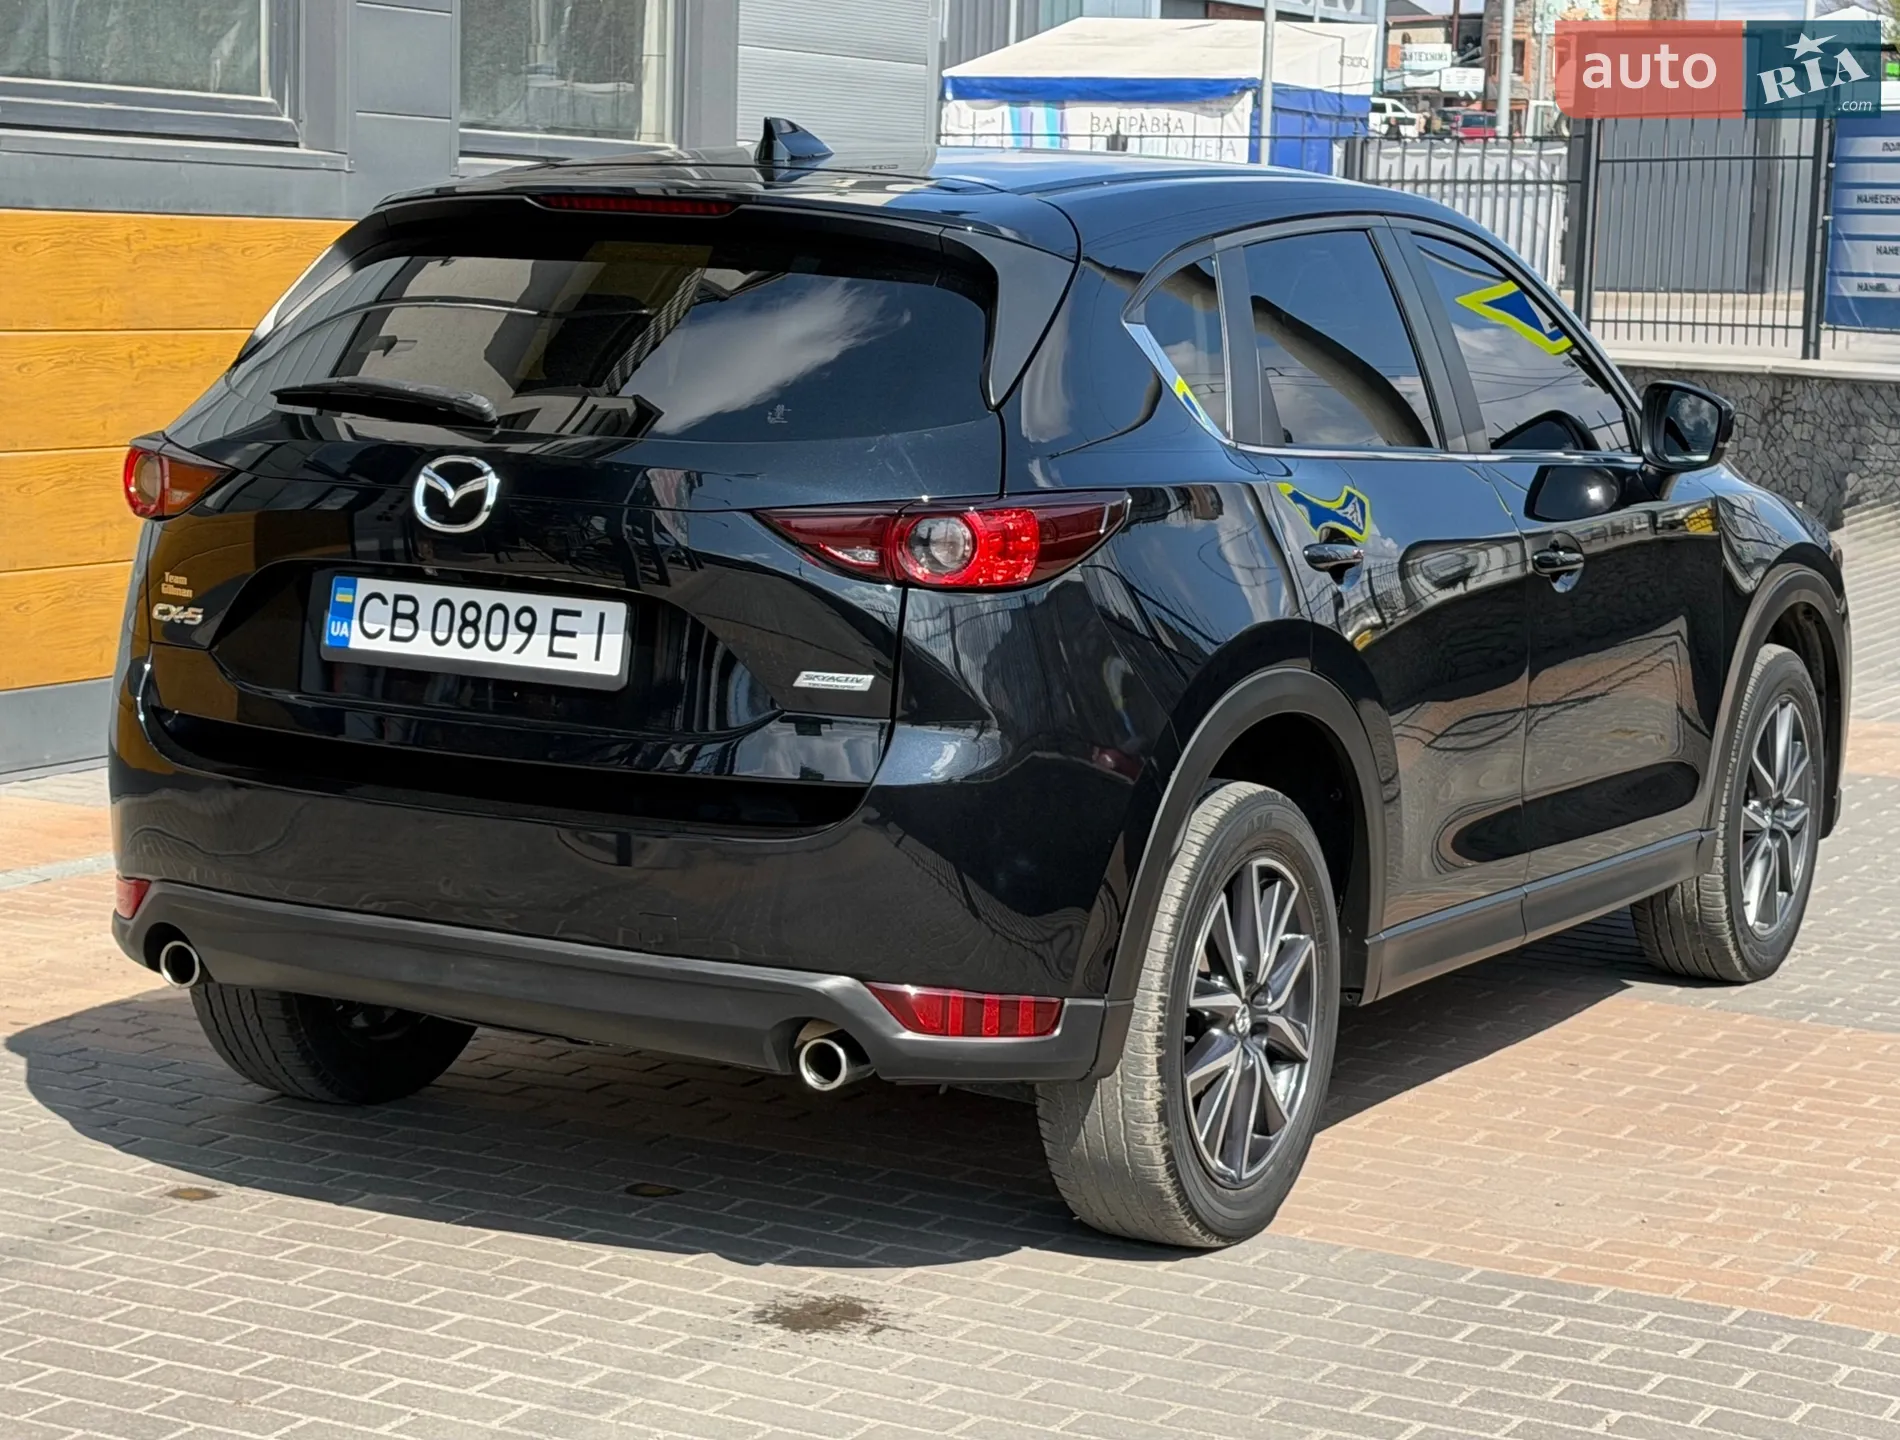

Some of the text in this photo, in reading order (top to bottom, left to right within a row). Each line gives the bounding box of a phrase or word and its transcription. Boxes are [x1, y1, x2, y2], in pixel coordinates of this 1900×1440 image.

[164, 571, 187, 585] Team
[330, 620, 349, 638] UA
[803, 673, 865, 683] SKYACTIV
